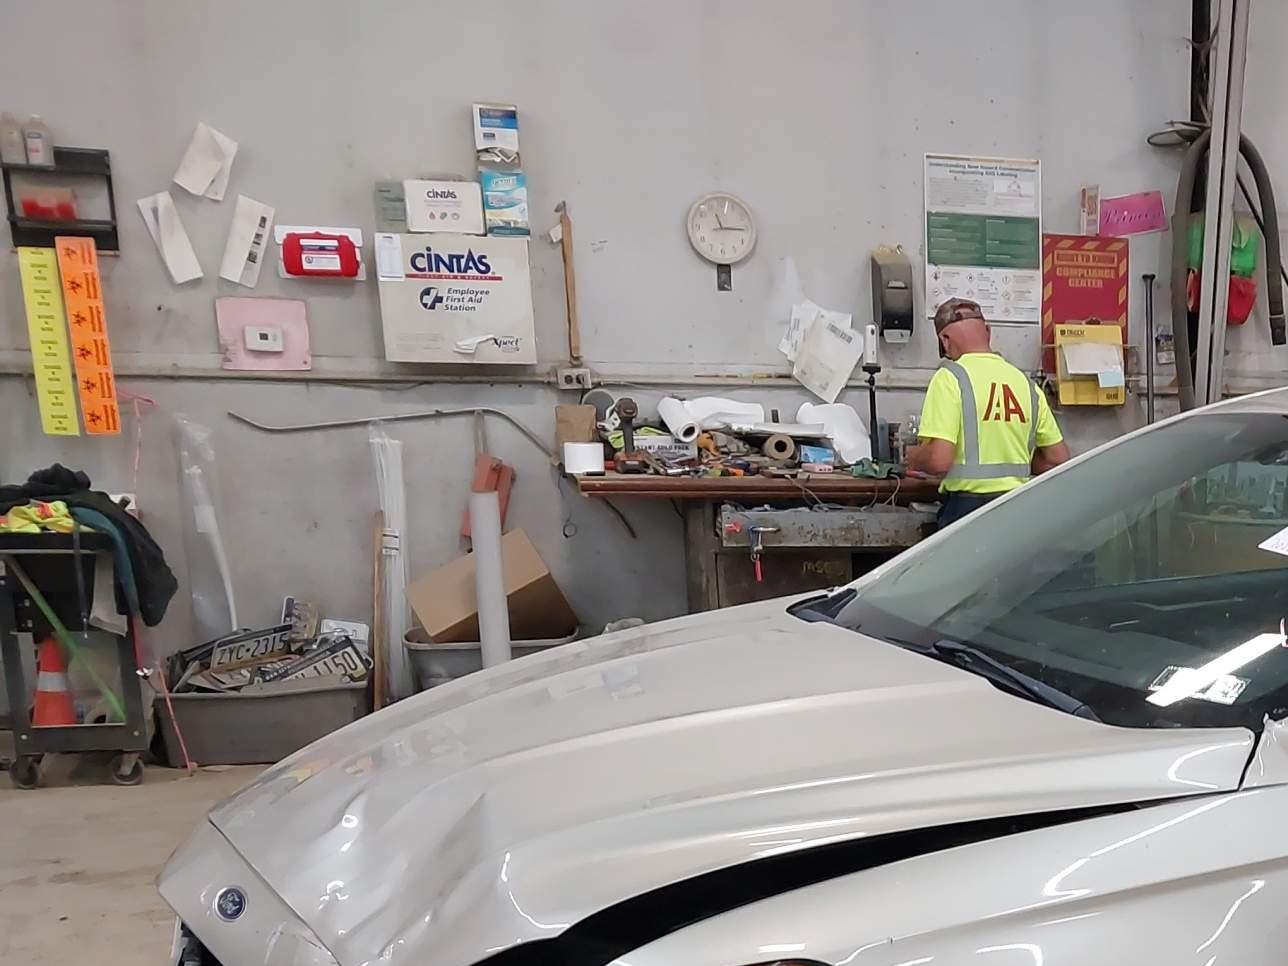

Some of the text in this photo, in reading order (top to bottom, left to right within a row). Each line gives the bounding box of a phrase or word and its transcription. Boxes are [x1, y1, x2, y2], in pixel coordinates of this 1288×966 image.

[1068, 278, 1104, 288] CENTER
[447, 288, 491, 297] Employee
[444, 303, 476, 312] Station
